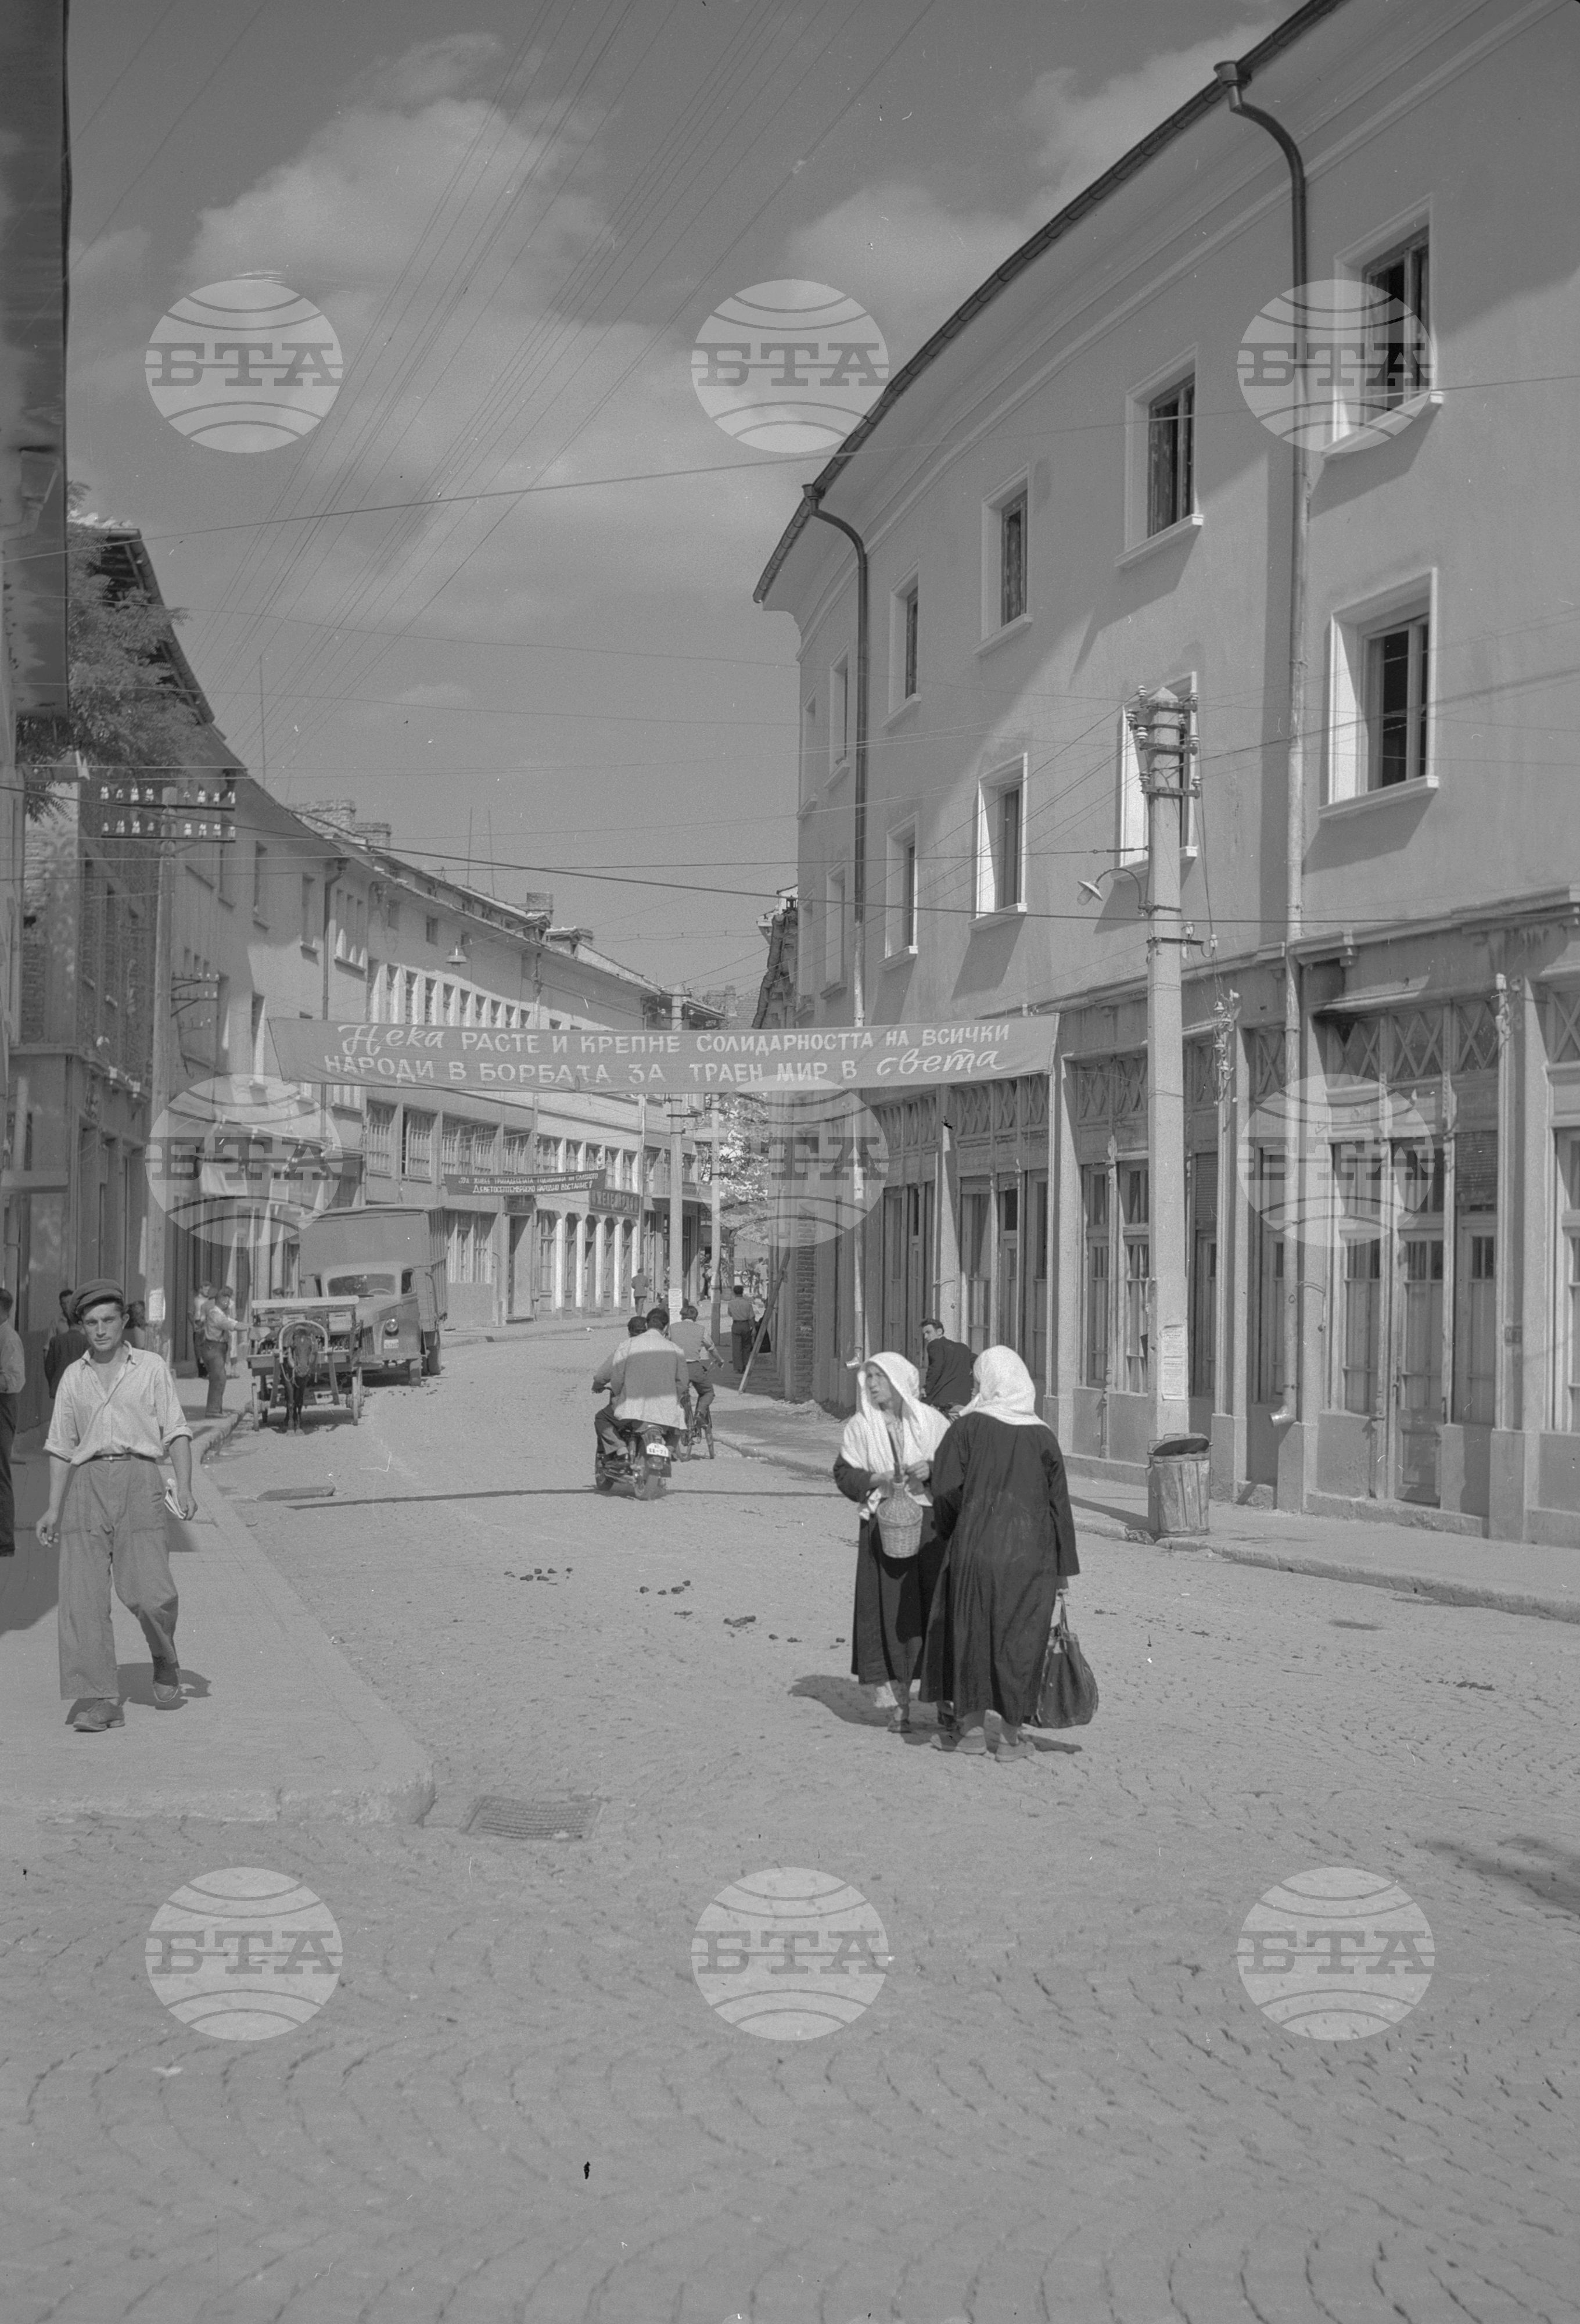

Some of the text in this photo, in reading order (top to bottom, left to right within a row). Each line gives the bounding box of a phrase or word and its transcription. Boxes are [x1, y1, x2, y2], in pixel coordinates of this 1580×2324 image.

[337, 1024, 1010, 1056] Нека РАСТЕ И КРЕПНЕ СОЛИДАРНОСТТА НА ВСИЧКИ
[324, 1048, 1008, 1084] НАРОДИ В БОРБАТА ЗА ТРАЕН МИР В света
